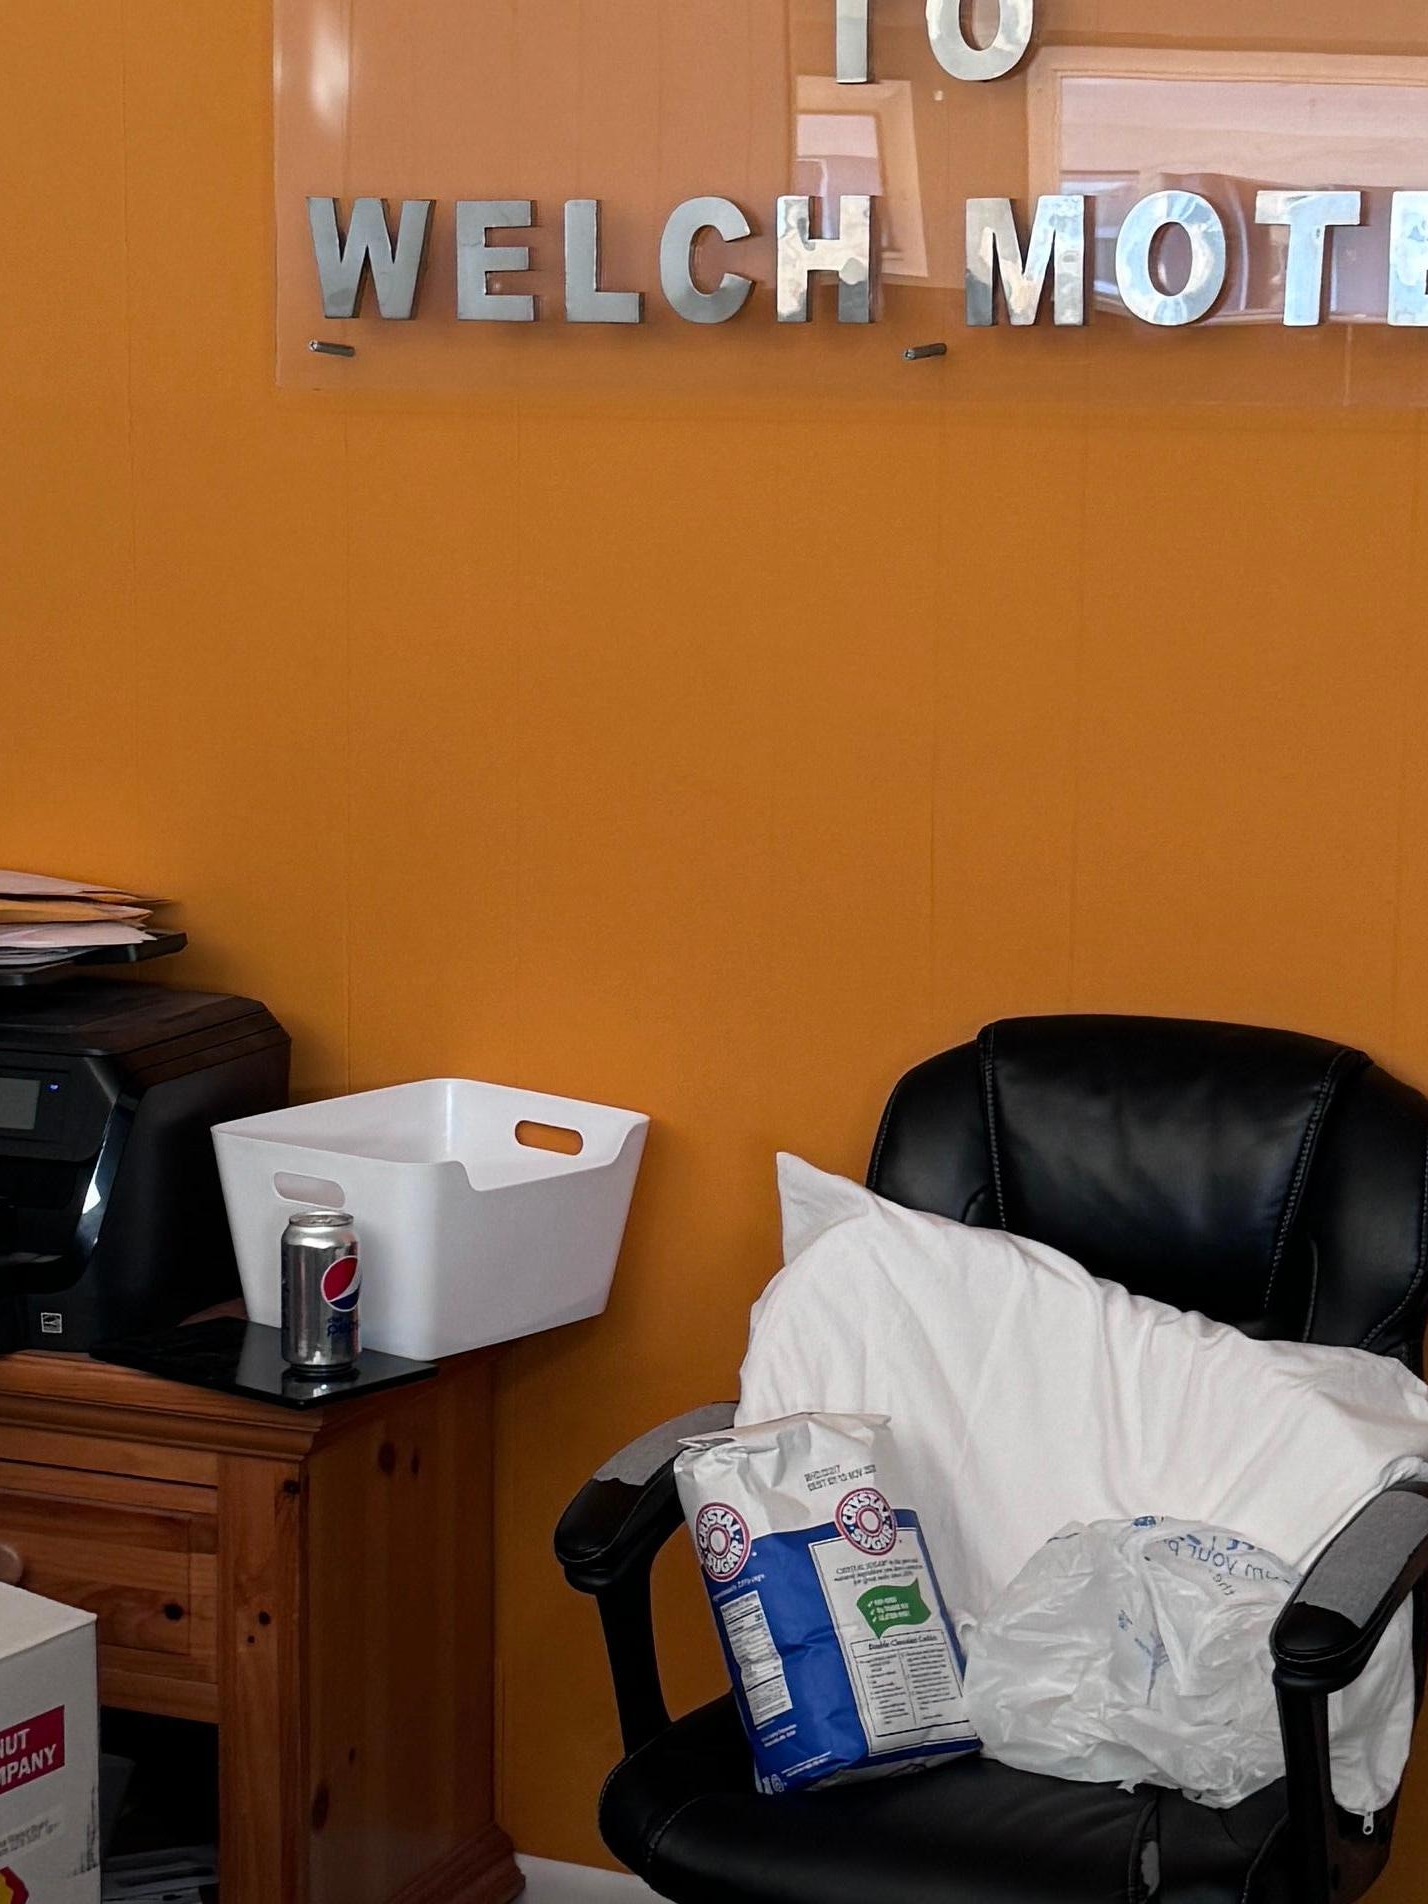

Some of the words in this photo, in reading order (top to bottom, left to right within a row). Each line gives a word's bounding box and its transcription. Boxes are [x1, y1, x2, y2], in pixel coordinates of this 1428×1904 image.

[306, 194, 874, 328] WELCH
[841, 1492, 893, 1525] CRYSTAL
[697, 1506, 741, 1554] CRYSTAL
[851, 1524, 895, 1551] SUGAR
[705, 1539, 744, 1575] SUGAR
